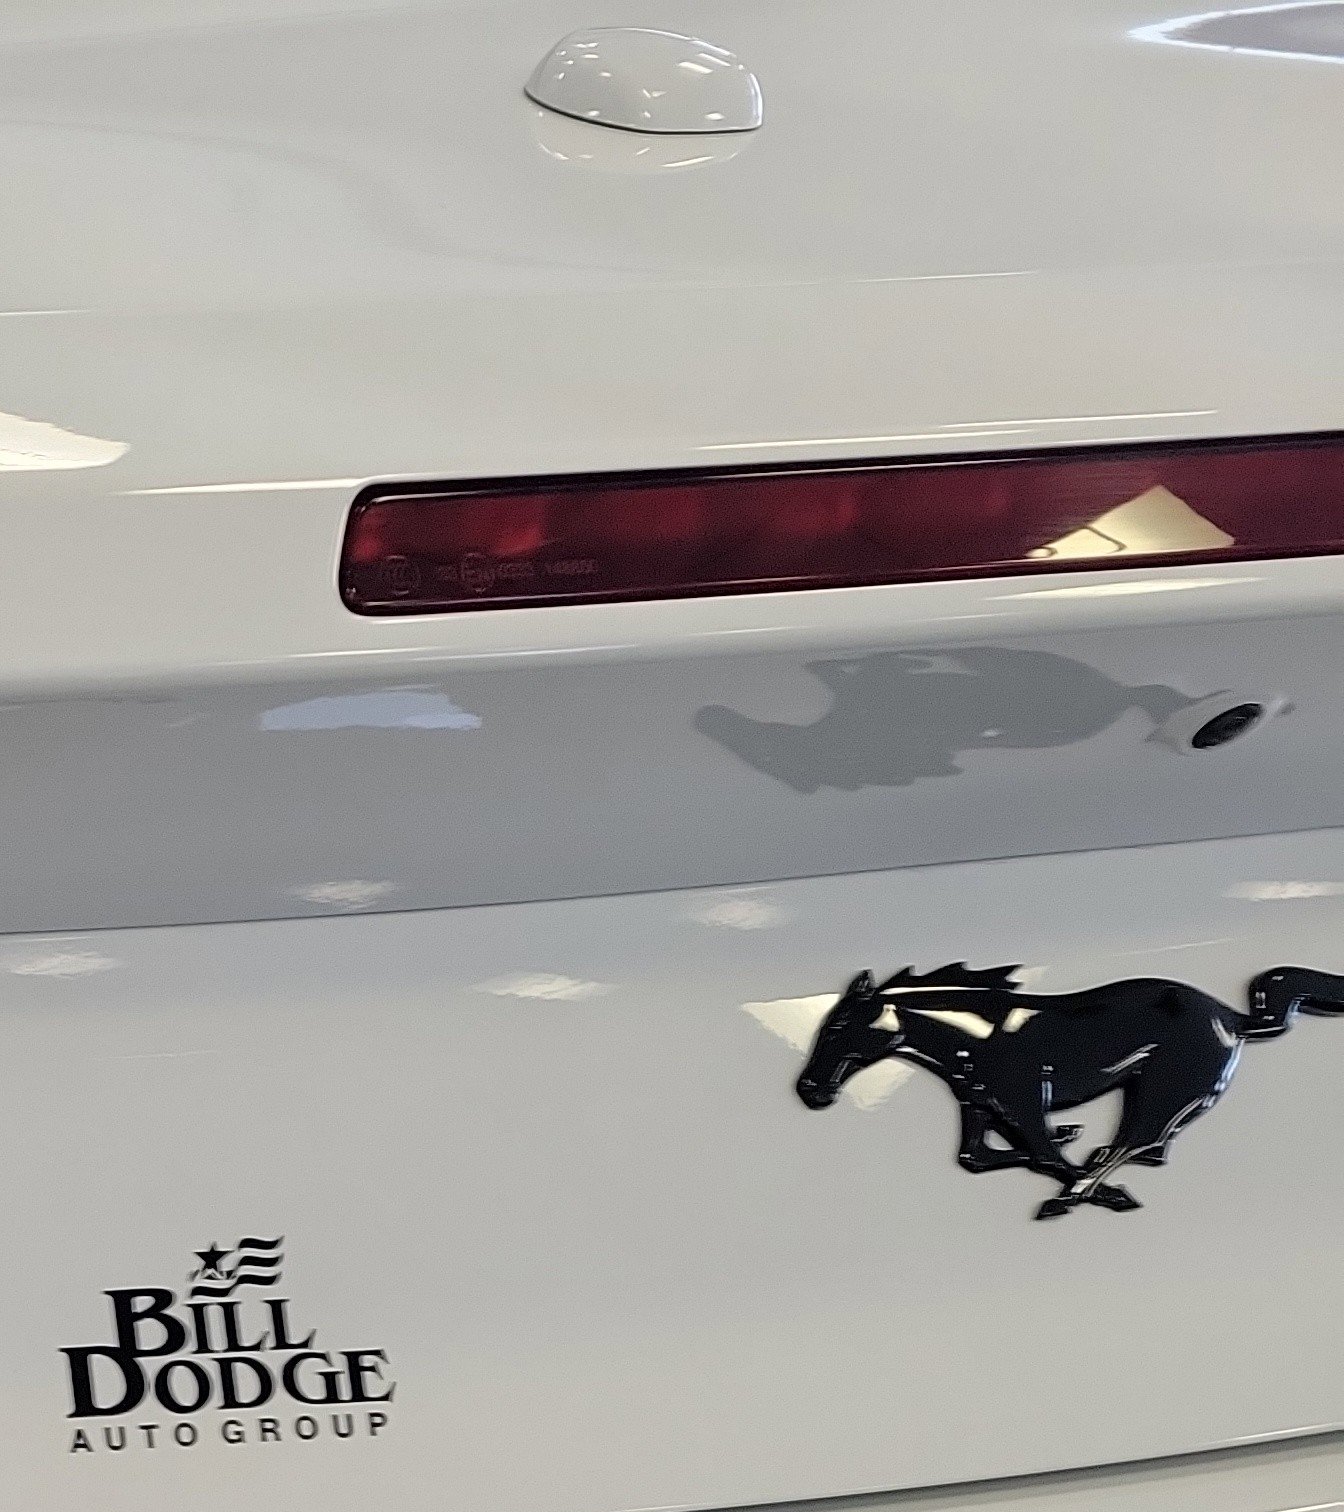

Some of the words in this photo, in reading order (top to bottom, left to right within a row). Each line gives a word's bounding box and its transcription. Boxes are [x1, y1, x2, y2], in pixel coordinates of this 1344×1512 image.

[101, 1287, 317, 1358] BILL
[58, 1345, 396, 1418] DODGE
[70, 1422, 199, 1453] AUTO
[221, 1412, 388, 1444] GROUP
